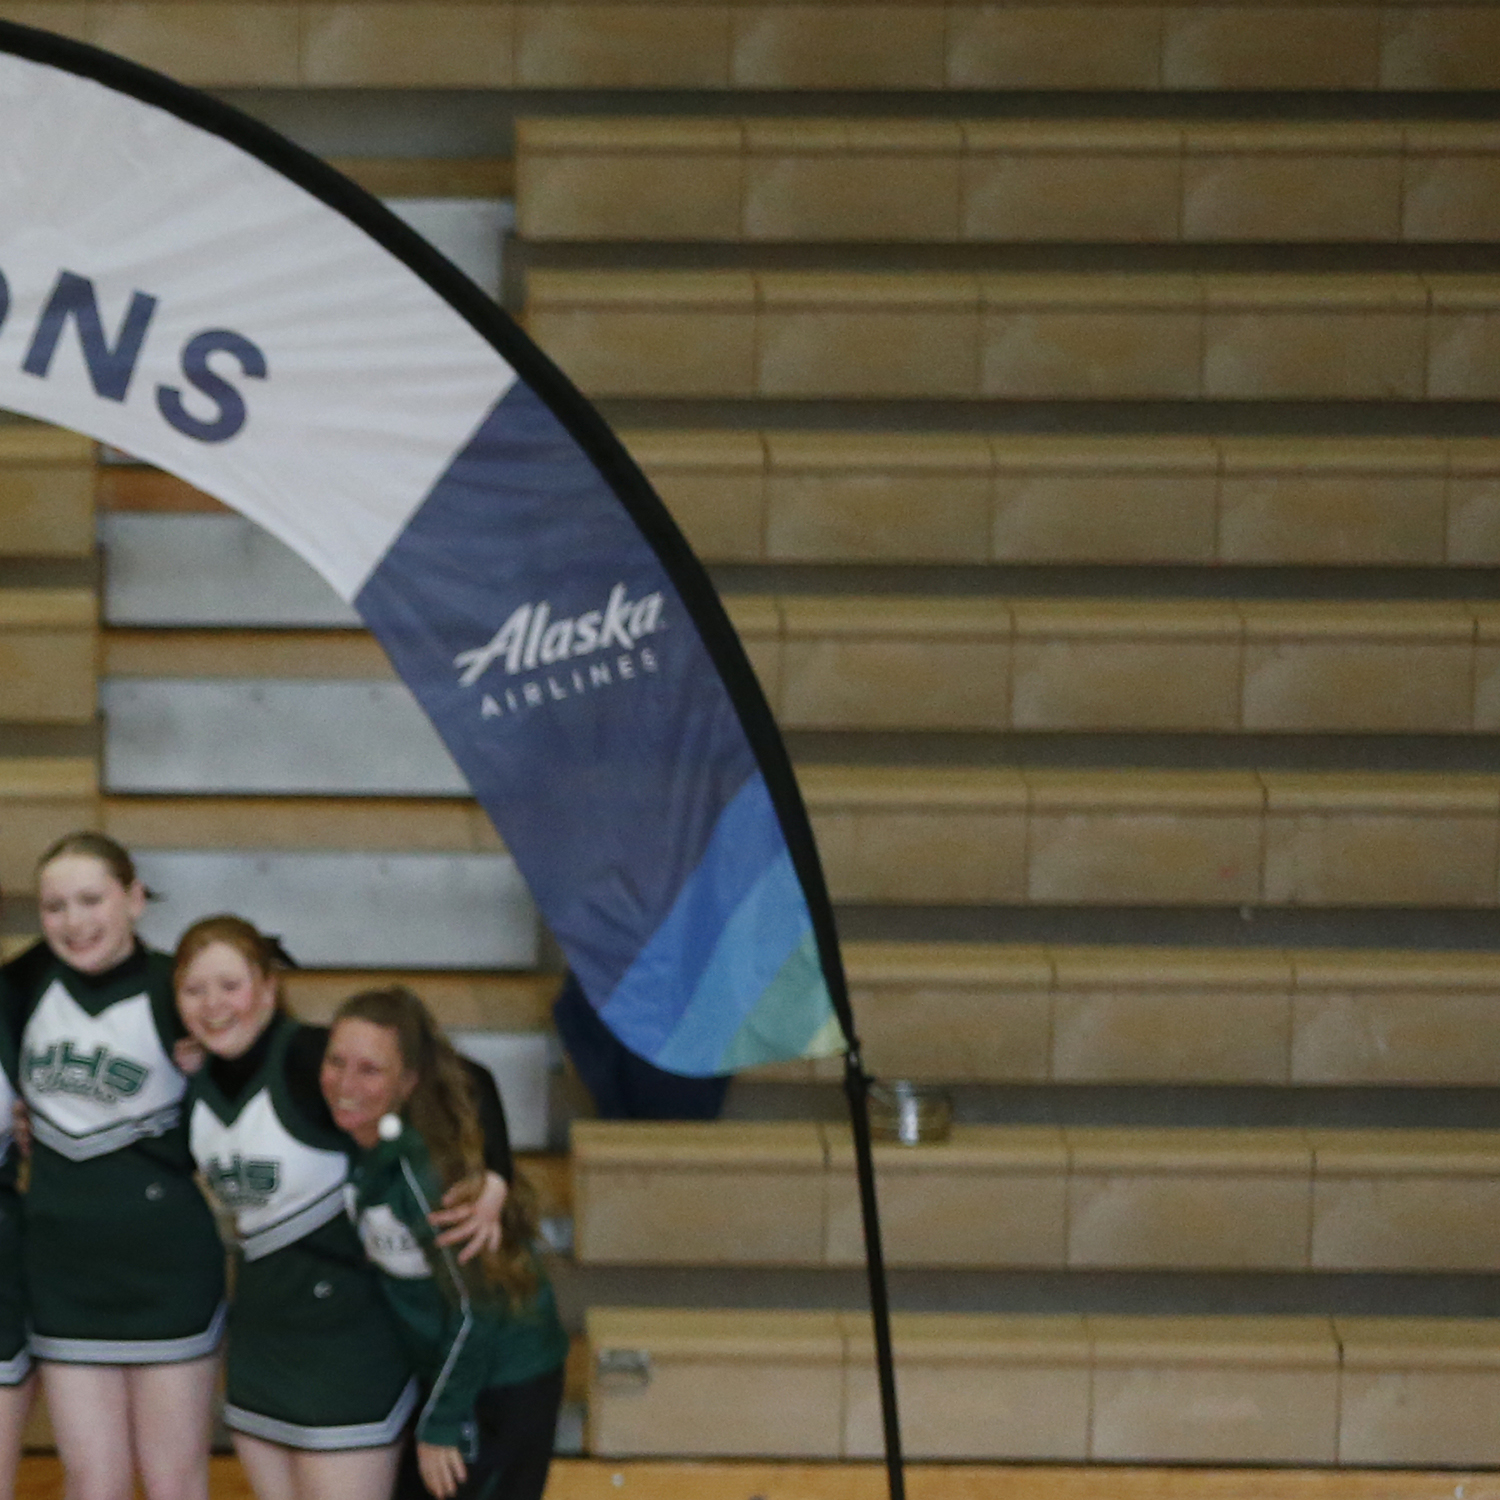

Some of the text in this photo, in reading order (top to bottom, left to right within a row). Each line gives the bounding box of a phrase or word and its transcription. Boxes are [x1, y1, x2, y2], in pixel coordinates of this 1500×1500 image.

[452, 581, 664, 688] Alaska
[480, 647, 658, 720] AIRLINES
[24, 1041, 148, 1098] HHS
